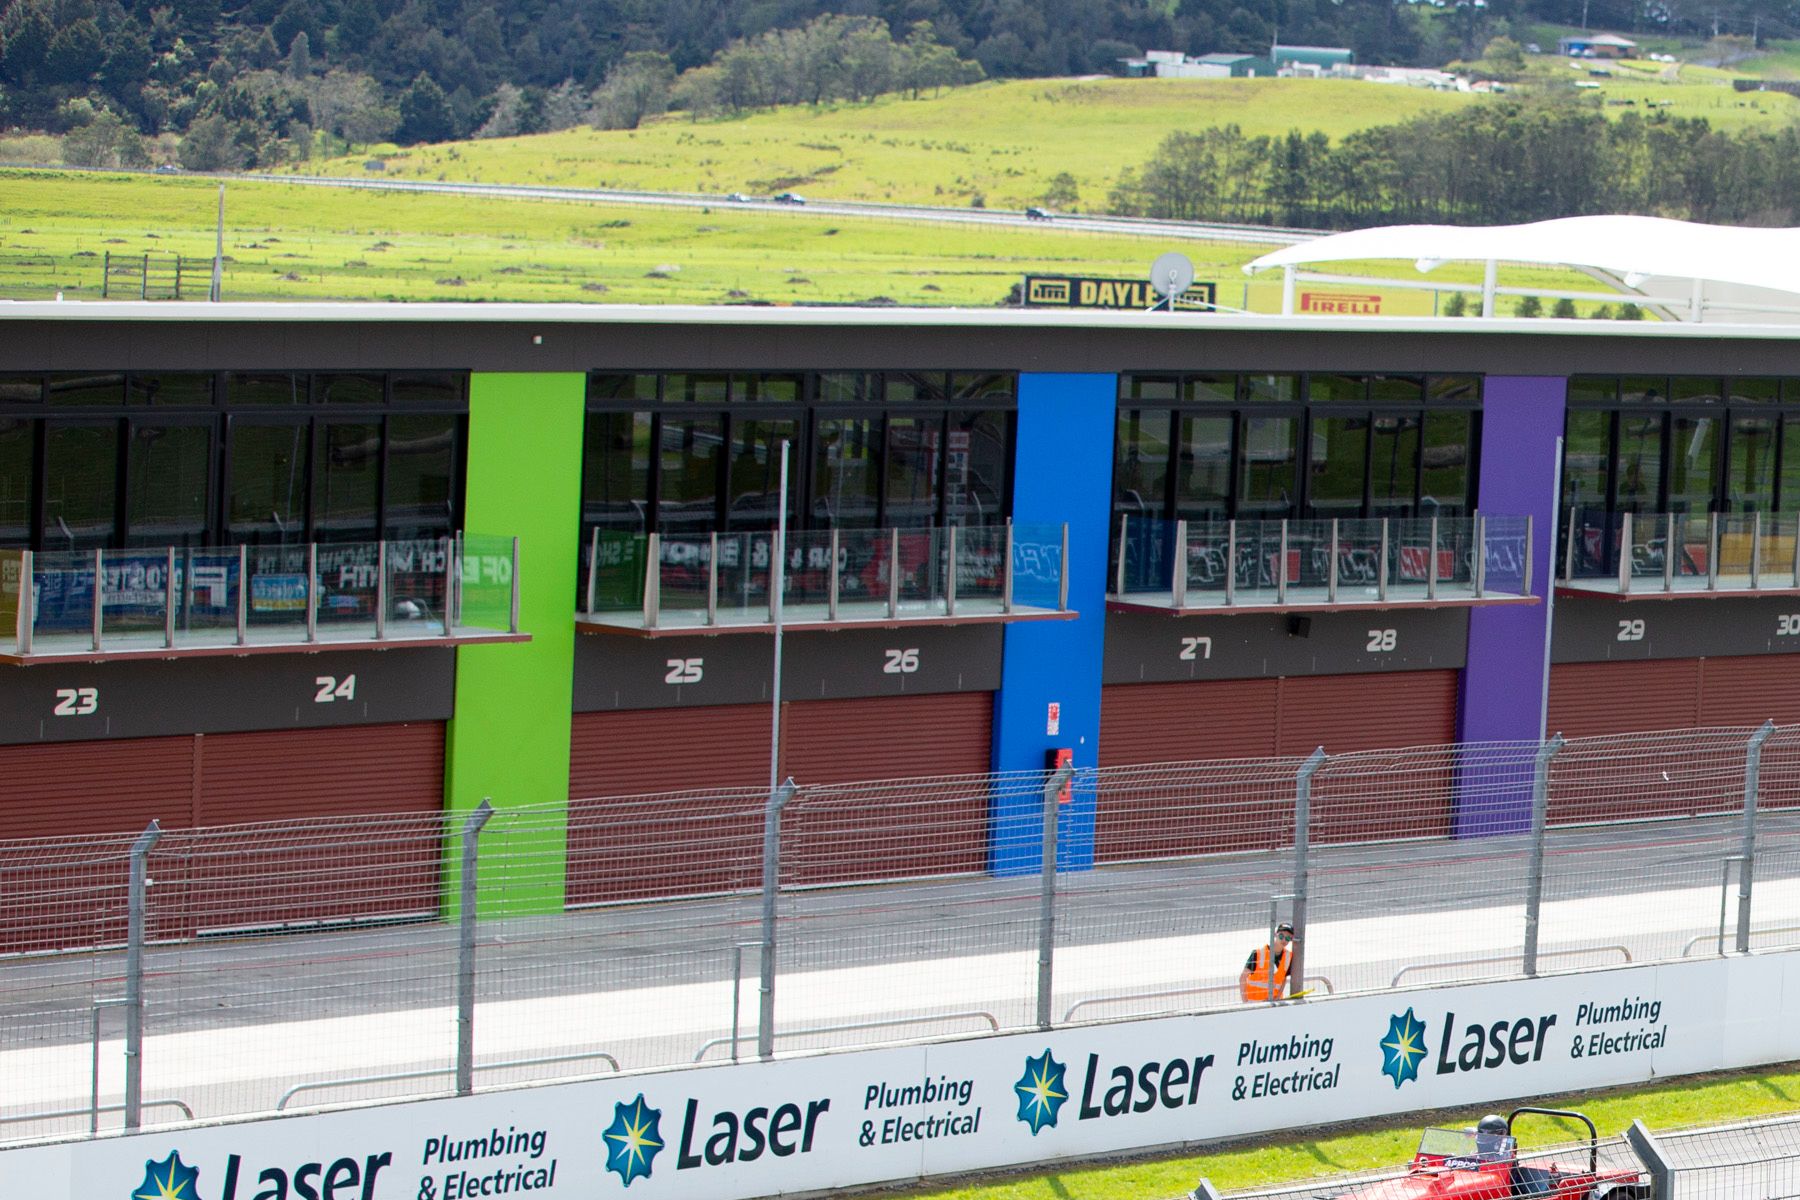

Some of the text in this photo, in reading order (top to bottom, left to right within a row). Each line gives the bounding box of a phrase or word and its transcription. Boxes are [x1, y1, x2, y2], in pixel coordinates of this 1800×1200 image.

[1302, 292, 1382, 315] PIRELLI
[1366, 628, 1397, 652] 28
[1617, 619, 1645, 641] 29
[883, 648, 919, 673] 26
[1180, 636, 1212, 660] 27
[665, 658, 703, 684] 25
[54, 687, 98, 716] 23
[315, 674, 356, 703] 24
[1575, 997, 1661, 1026] Plumbing
[1237, 1033, 1334, 1066] Plumbing
[1436, 1011, 1557, 1075] Laser
[1570, 1024, 1667, 1059] & Electrical
[864, 1076, 974, 1110] Plumbing
[1079, 1053, 1214, 1120] Laser
[1231, 1063, 1341, 1101] & Electrical
[676, 1097, 831, 1170] Laser
[858, 1107, 982, 1147] & Electrical
[422, 1126, 547, 1165] Plumbing
[442, 1159, 557, 1200] Electrical
